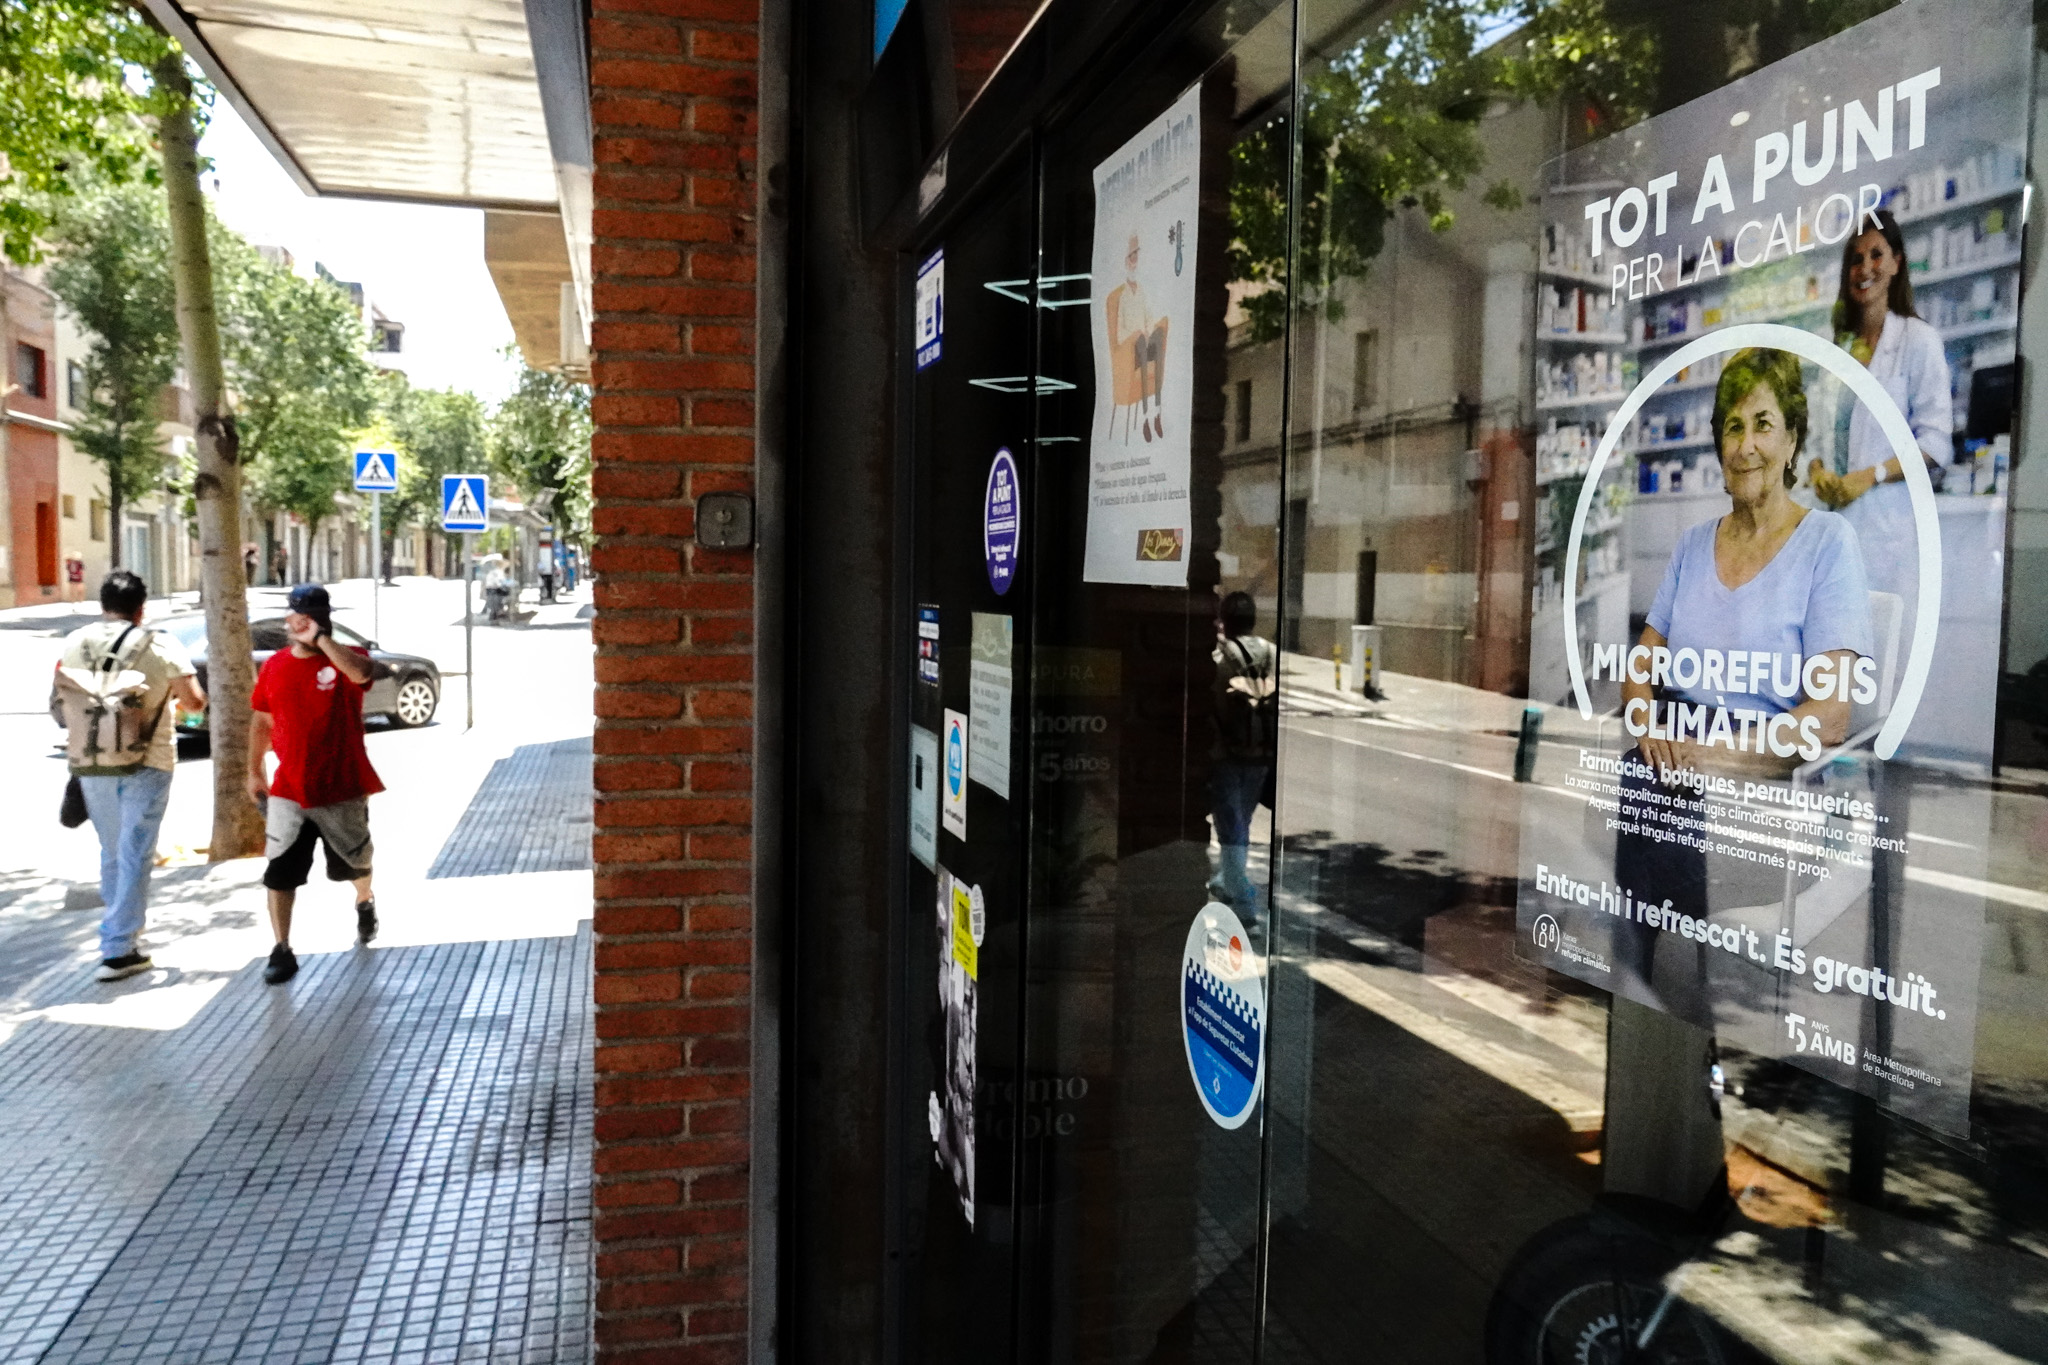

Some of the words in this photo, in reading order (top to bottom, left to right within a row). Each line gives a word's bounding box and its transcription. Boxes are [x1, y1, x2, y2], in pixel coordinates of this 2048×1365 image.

[1585, 171, 1678, 258] TOT
[1691, 153, 1735, 225] A
[1752, 66, 1941, 204] PUNT
[1611, 252, 1665, 306] PER
[1677, 236, 1721, 286] LA
[1733, 183, 1884, 269] CALOR
[1592, 642, 1878, 705] MICROREFUGIS
[1624, 695, 1822, 762] CLIMÀTICS
[1565, 774, 1575, 787] La
[1577, 778, 1601, 792] xarxa
[1602, 783, 1672, 806] metropolitana
[1673, 794, 1687, 809] de
[1688, 798, 1726, 819] refugis
[1728, 803, 1782, 828] climàtics
[1784, 819, 1843, 841] continua
[1846, 830, 1909, 854] creixent.
[1579, 749, 1657, 785] Farmàcies,
[1661, 761, 1740, 800] botigues,
[1744, 781, 1889, 823] perruqueries...
[1588, 795, 1621, 812] Aquest
[1622, 803, 1641, 820] any
[1642, 806, 1658, 821] s'hi
[1660, 812, 1713, 832] afegeixen
[1714, 820, 1765, 845] botigues
[1767, 831, 1771, 846] i
[1774, 836, 1814, 856] espais
[1816, 844, 1865, 866] privats
[1606, 817, 1640, 835] perquè
[1641, 823, 1676, 843] tinguis
[1677, 832, 1714, 853] refugis
[1715, 843, 1757, 862] encara
[1759, 851, 1785, 869] més
[1787, 860, 1796, 872] a
[1798, 860, 1832, 881] prop.
[1535, 863, 1621, 917] Entra-hi
[1625, 889, 1633, 920] i
[1636, 898, 1767, 963] refresca't.
[1774, 928, 1806, 974] És
[1812, 955, 1947, 1021] gratuït.
[1561, 949, 1582, 963] refugis
[1583, 956, 1611, 973] climàtics
[1810, 1031, 1856, 1066] AMB
[1811, 1020, 1830, 1034] ANYS
[1862, 1062, 1873, 1074] de
[1875, 1066, 1915, 1090] Barcelona
[1863, 1047, 1882, 1064] Àrea
[1883, 1057, 1942, 1087] Metropolitana
